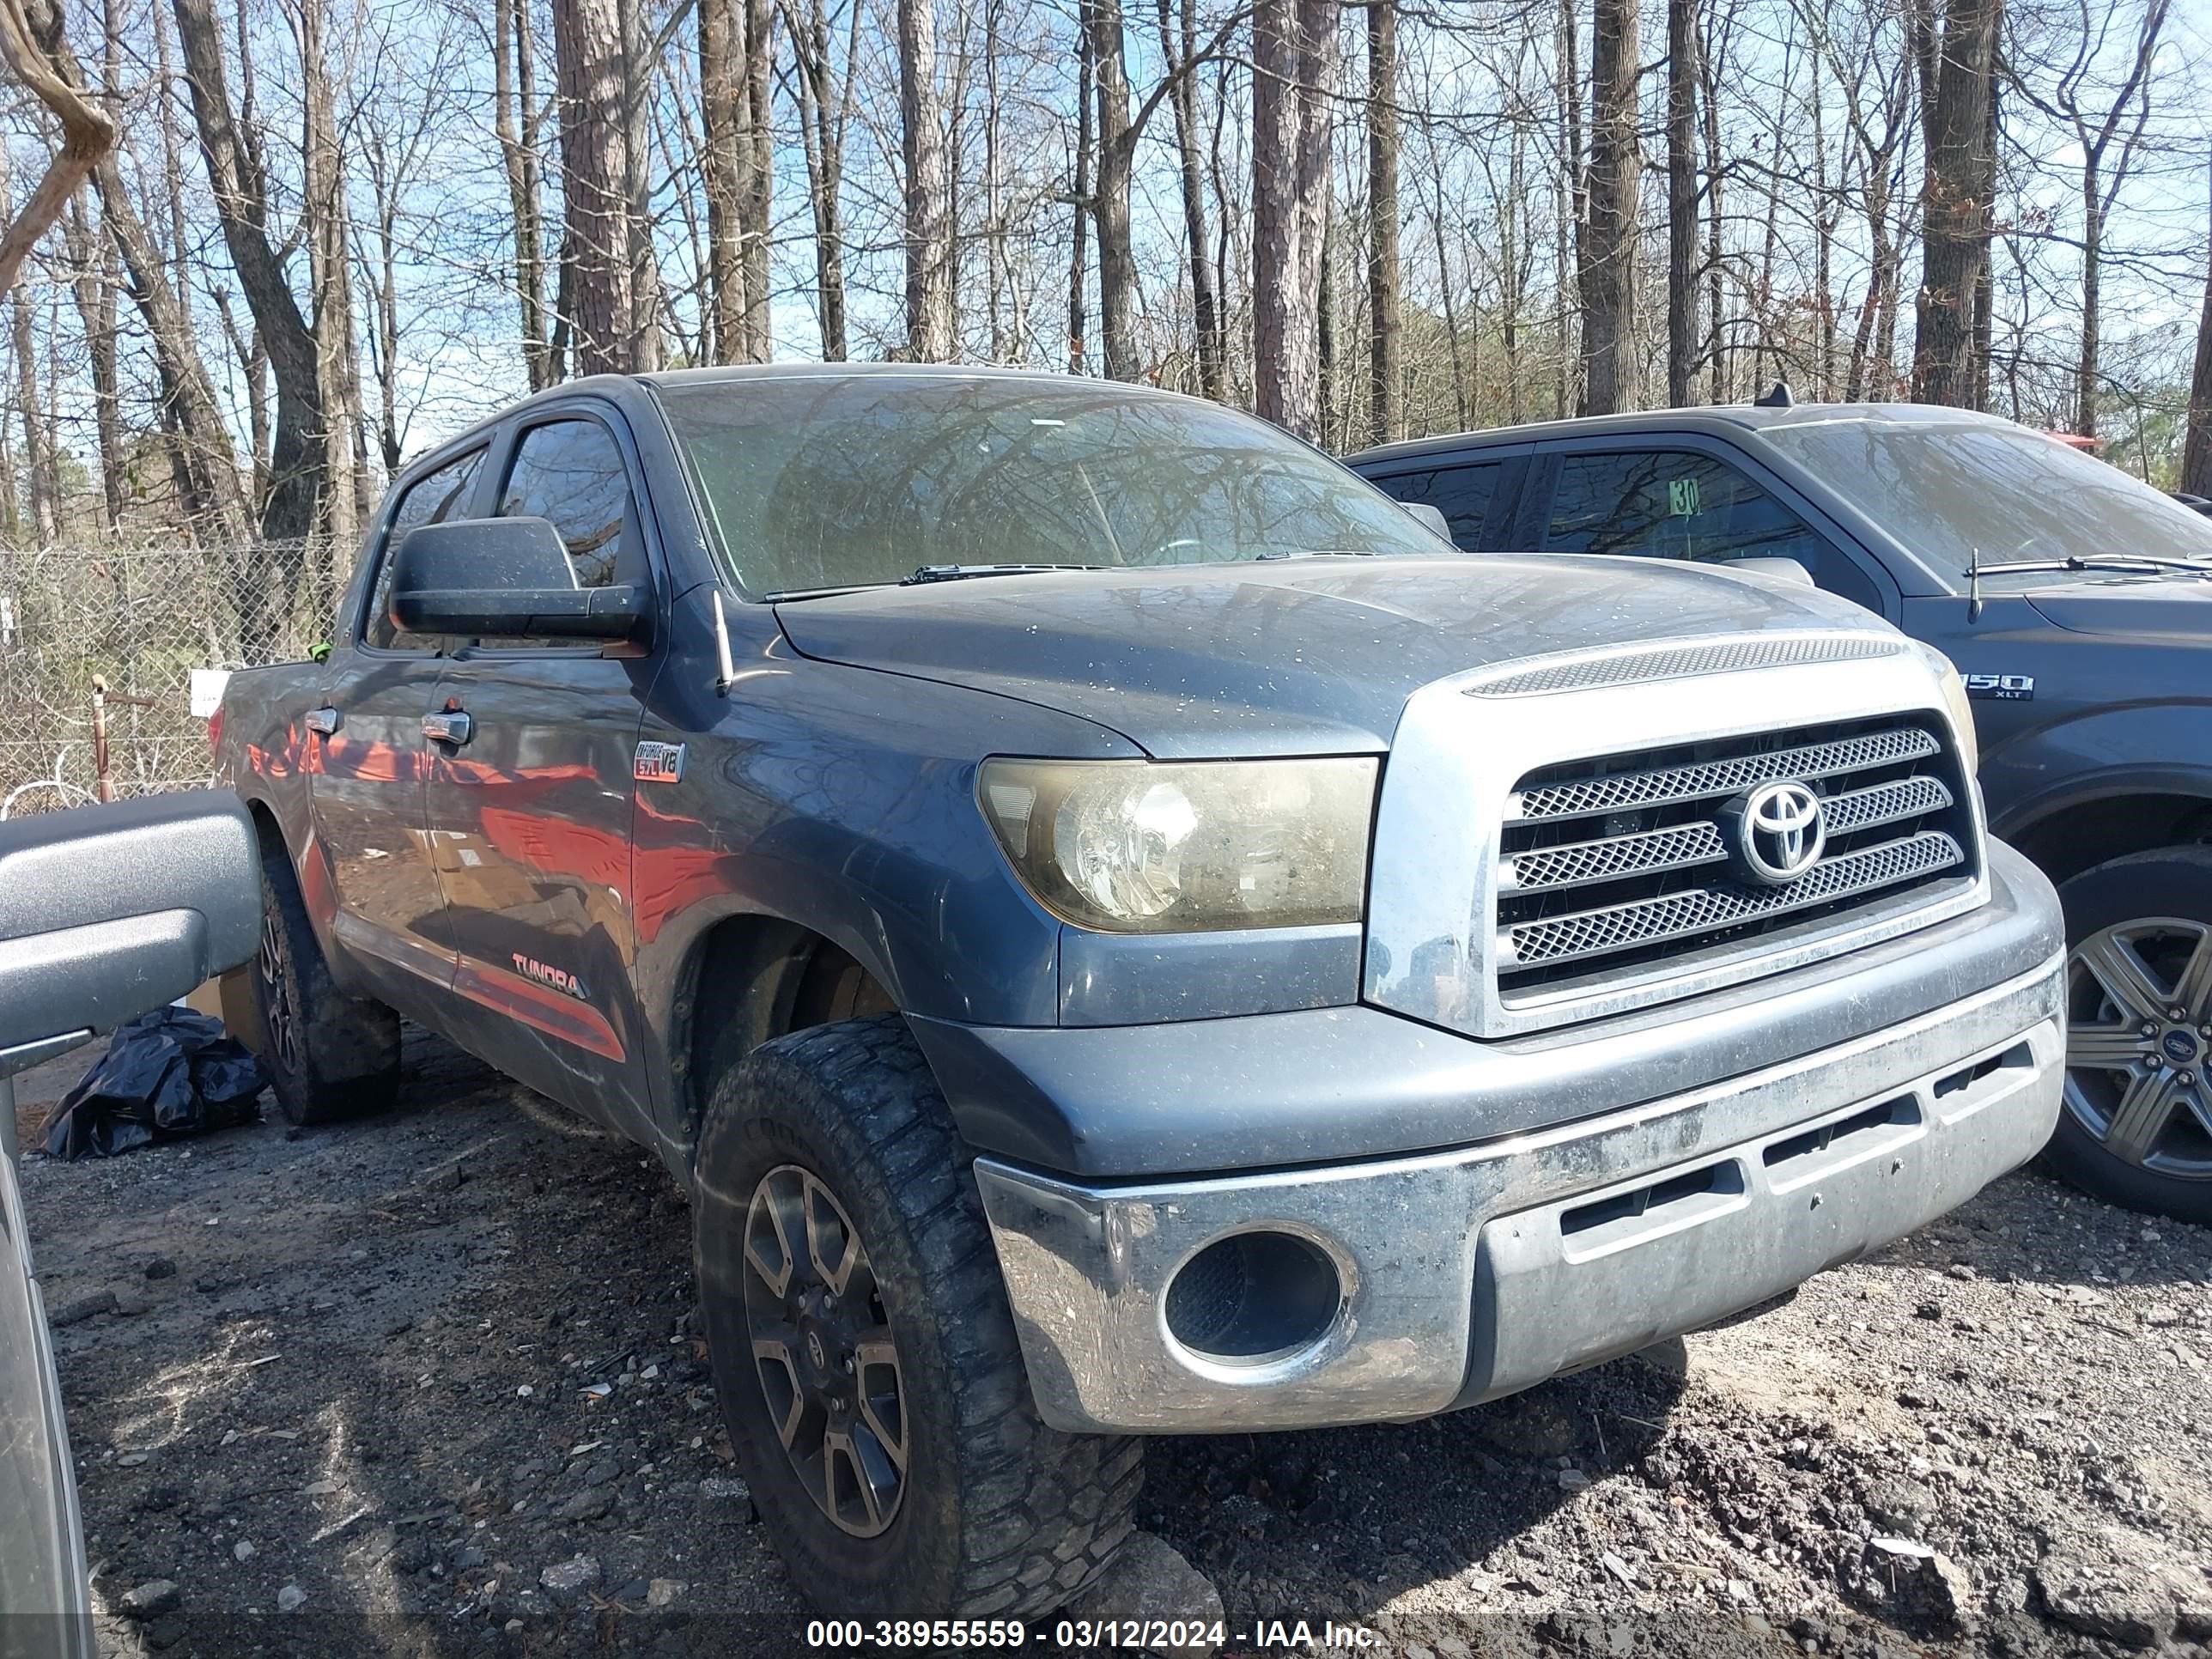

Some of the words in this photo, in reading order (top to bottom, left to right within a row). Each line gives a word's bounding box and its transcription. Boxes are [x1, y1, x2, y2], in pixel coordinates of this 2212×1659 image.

[1674, 480, 1696, 513] 30
[661, 750, 678, 774] V8
[512, 952, 586, 1000] TUNDRA
